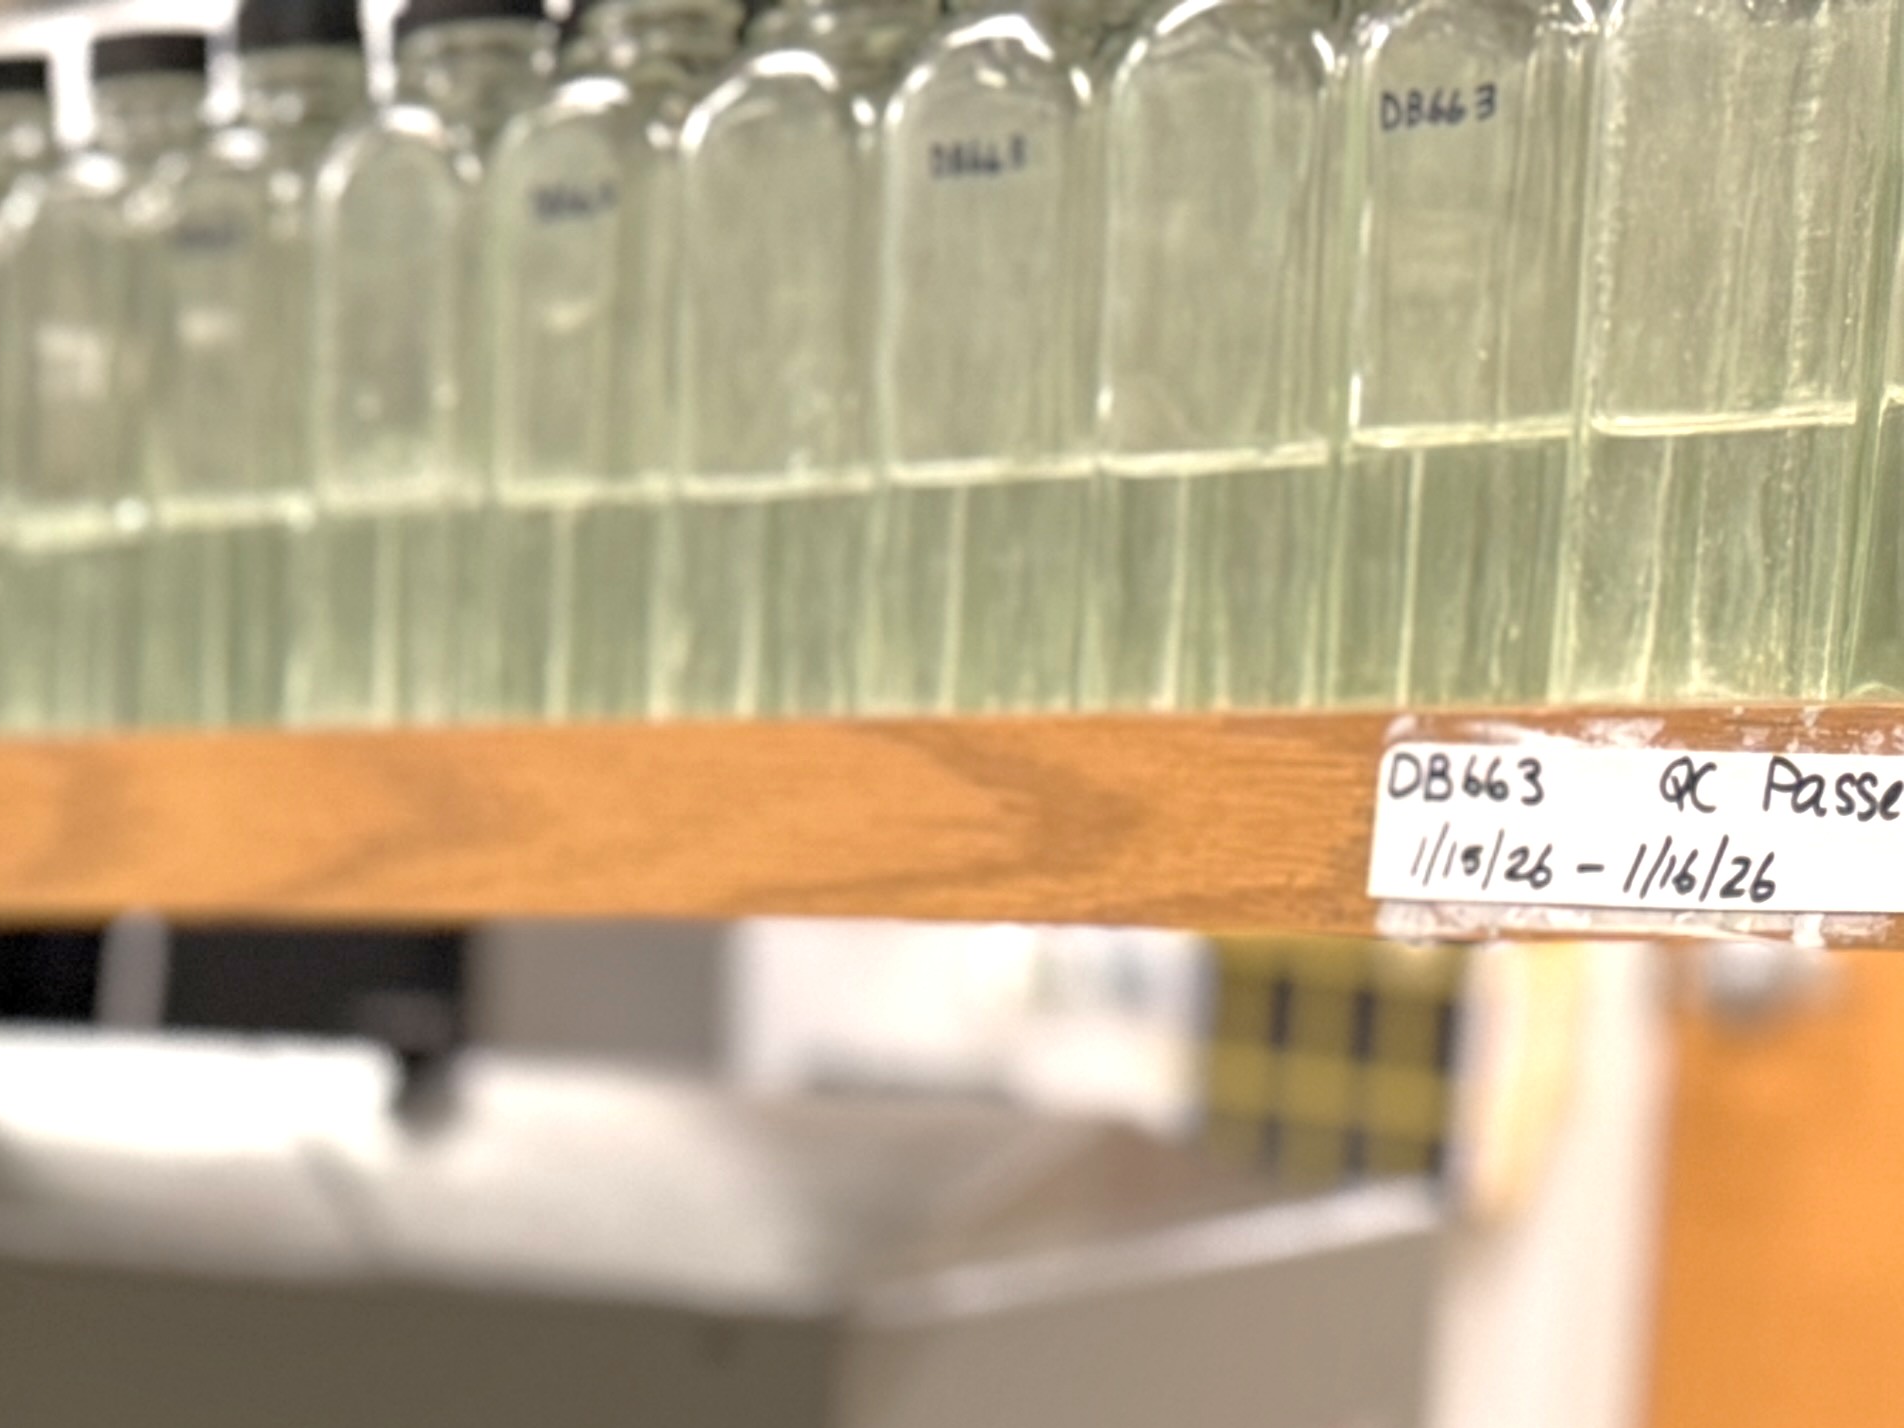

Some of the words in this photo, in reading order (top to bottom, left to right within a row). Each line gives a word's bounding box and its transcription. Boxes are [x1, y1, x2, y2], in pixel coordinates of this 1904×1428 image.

[1379, 79, 1498, 133] DB663
[1387, 752, 1545, 807] DB663
[1659, 755, 1718, 814] QC
[1761, 755, 1904, 823] Passe
[1410, 821, 1554, 890] 1/15/26
[1622, 833, 1777, 903] 1/16/26
